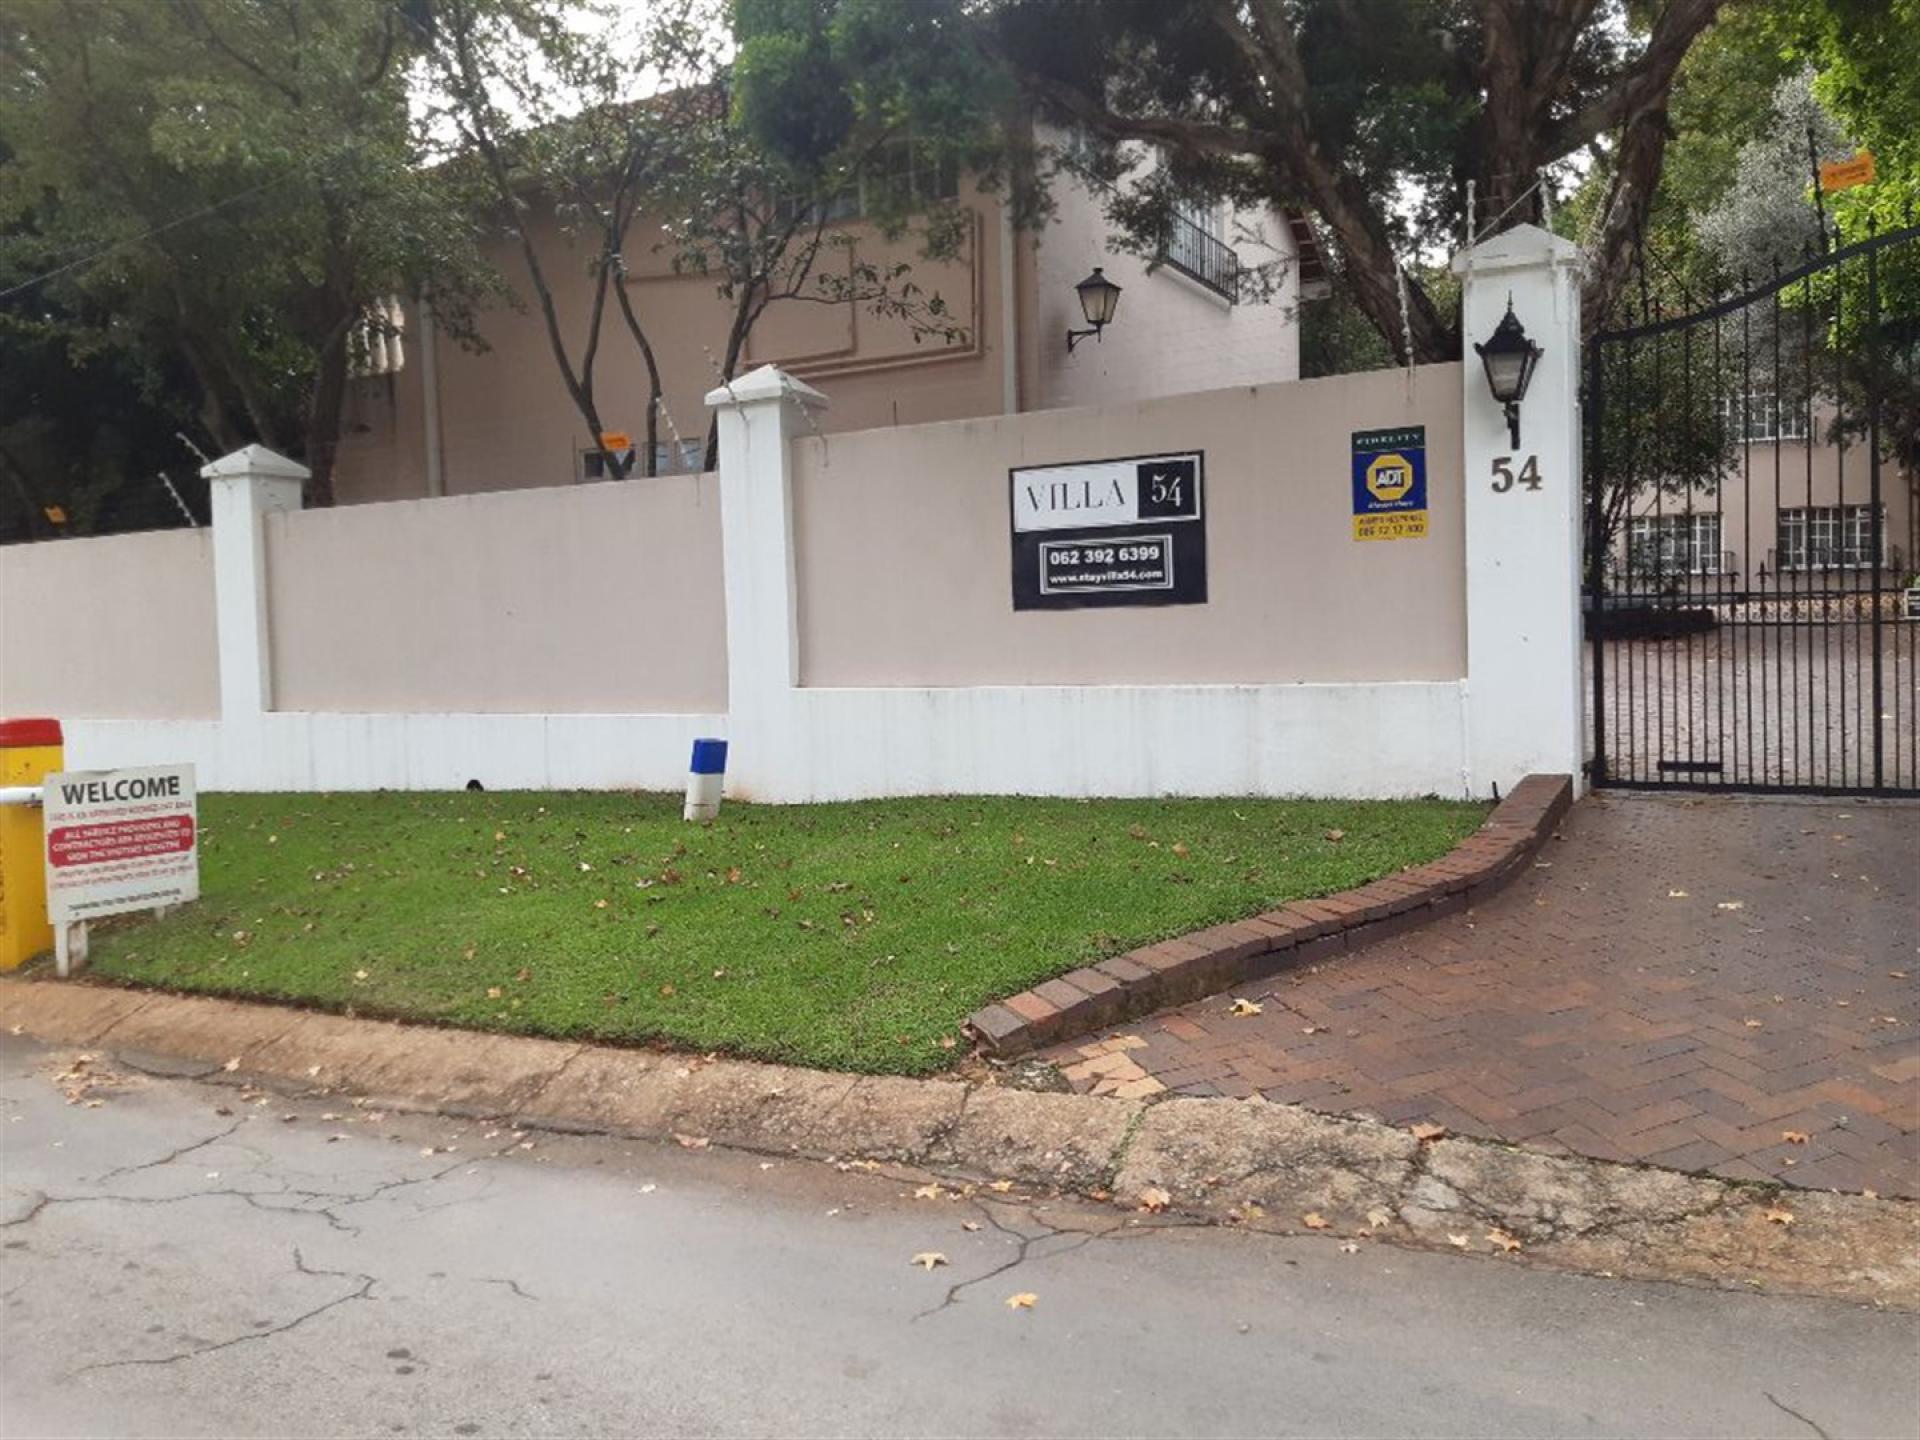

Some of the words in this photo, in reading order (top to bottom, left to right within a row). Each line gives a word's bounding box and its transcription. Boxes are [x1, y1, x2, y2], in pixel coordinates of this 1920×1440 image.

[1376, 469, 1404, 486] ADT
[1491, 455, 1543, 493] 54
[1027, 479, 1125, 511] VILLA
[1151, 473, 1183, 507] 54
[1050, 551, 1080, 565] 062
[1084, 549, 1114, 564] 392
[1118, 546, 1160, 561] 6399
[1049, 569, 1163, 584] www.stayvilla54.com
[61, 776, 180, 805] WELCOME
